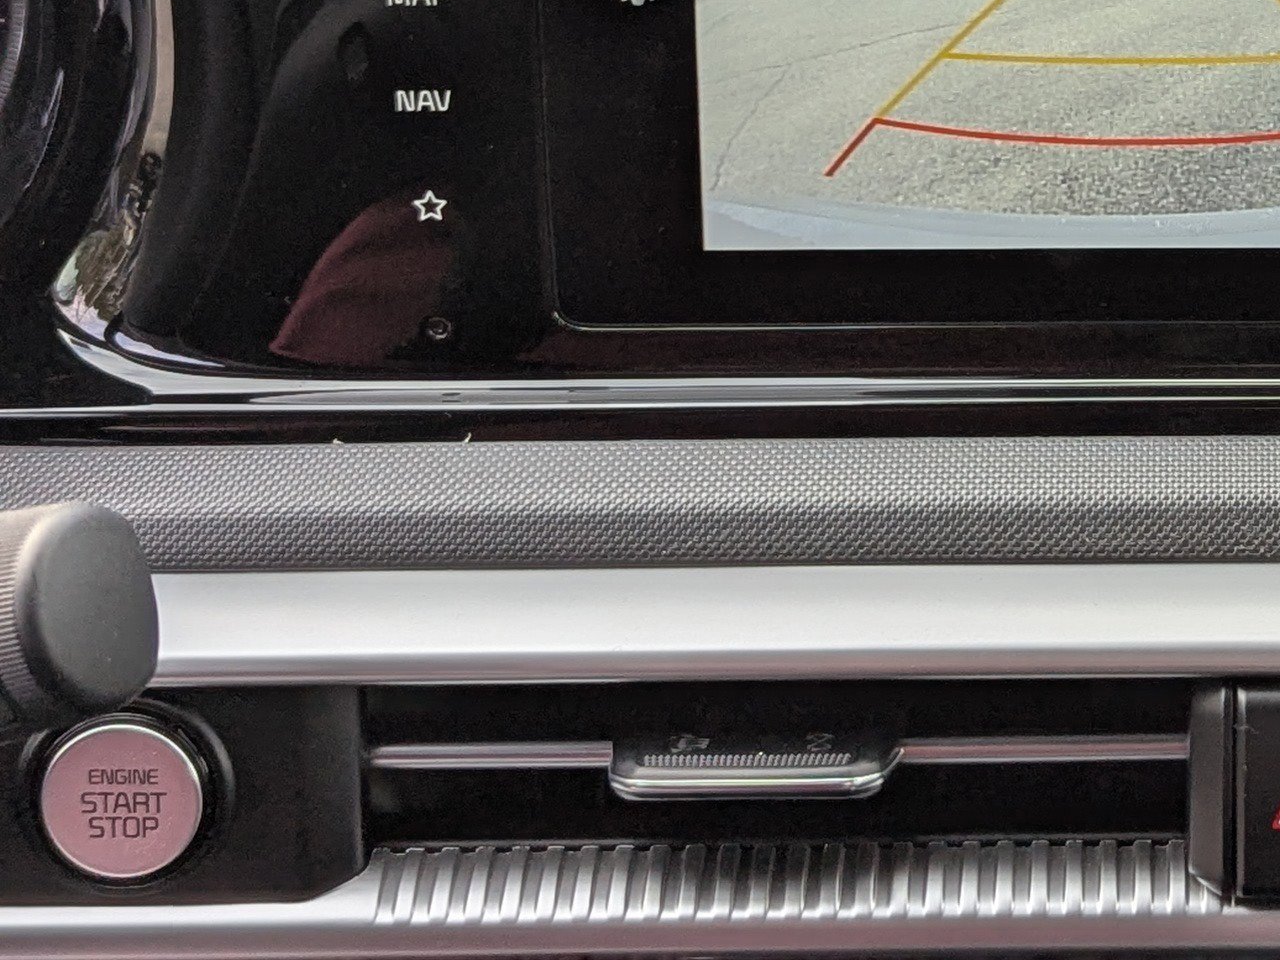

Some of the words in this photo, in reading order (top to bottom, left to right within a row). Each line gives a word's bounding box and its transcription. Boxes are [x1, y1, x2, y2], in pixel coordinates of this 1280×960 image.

[394, 89, 453, 113] NAV
[88, 768, 159, 785] ENGINE
[80, 791, 168, 814] START
[88, 816, 159, 839] STOP
